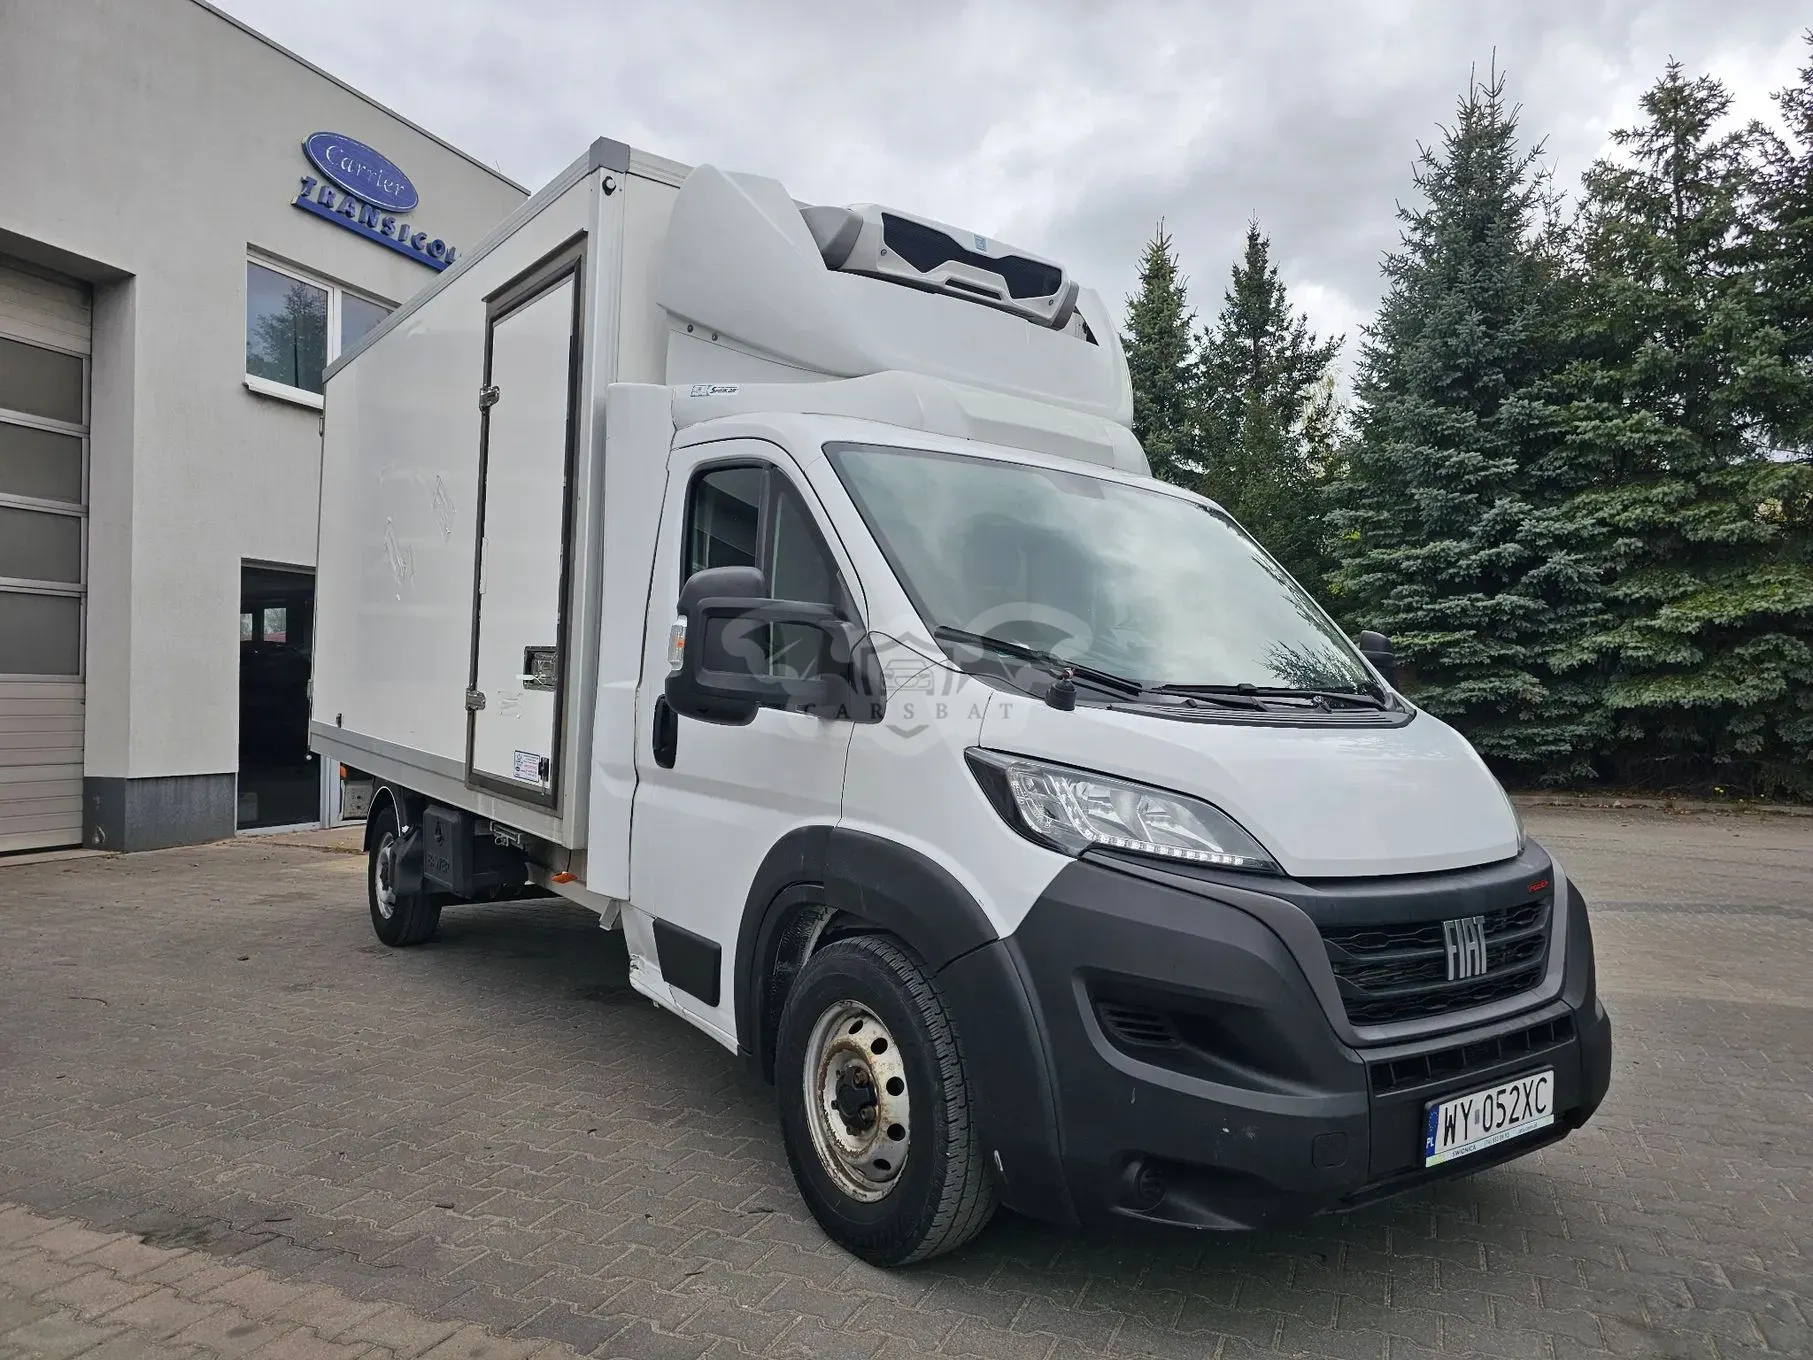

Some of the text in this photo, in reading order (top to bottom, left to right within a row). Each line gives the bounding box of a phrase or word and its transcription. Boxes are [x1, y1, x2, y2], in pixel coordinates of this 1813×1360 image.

[326, 145, 405, 196] Carrier
[300, 176, 461, 264] TRANSICOL
[1444, 916, 1487, 981] FIAT
[1426, 1136, 1434, 1149] PL
[1444, 1077, 1548, 1146] WY 052XC
